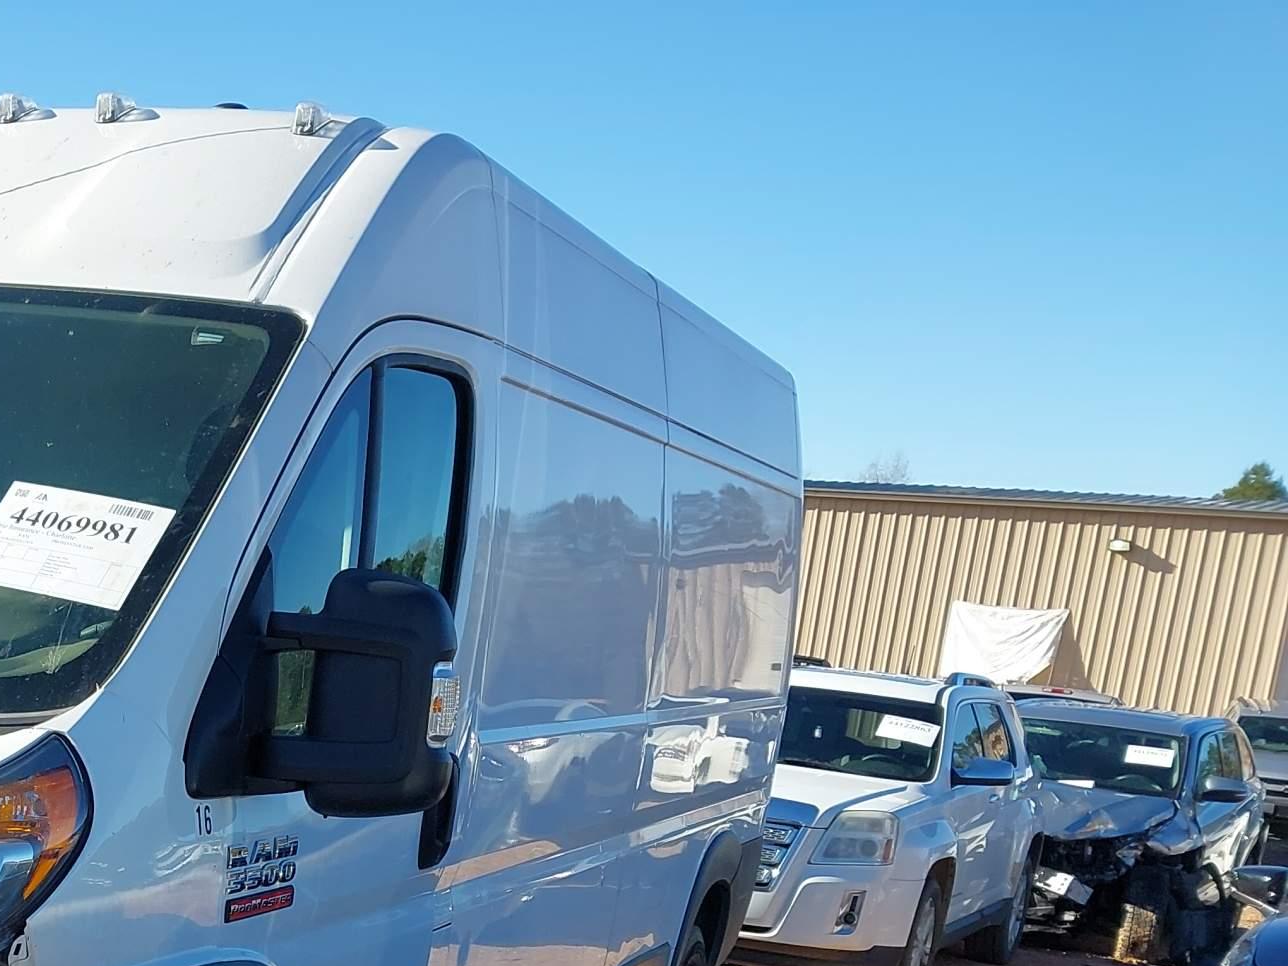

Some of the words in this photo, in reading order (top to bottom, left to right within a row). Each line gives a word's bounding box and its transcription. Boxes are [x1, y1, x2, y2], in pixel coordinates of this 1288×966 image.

[10, 506, 139, 545] 44069981
[195, 804, 213, 836] 16
[226, 836, 299, 869] RAM
